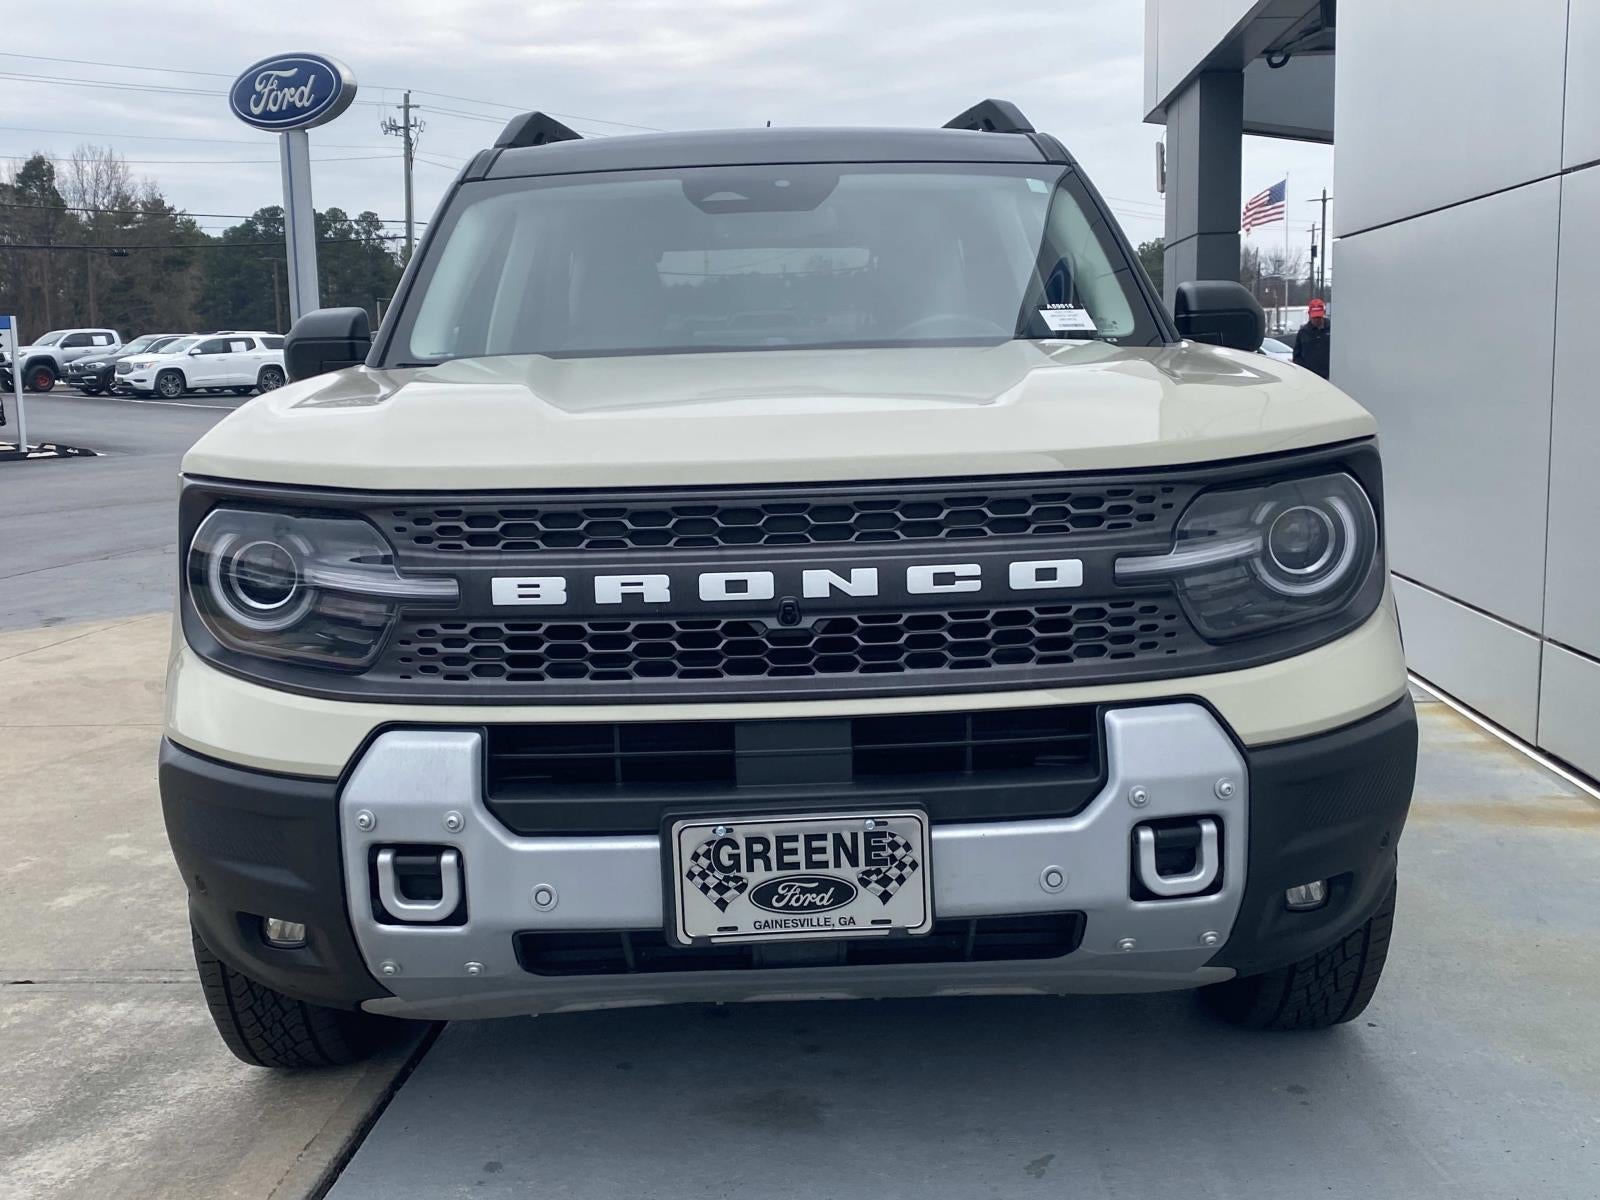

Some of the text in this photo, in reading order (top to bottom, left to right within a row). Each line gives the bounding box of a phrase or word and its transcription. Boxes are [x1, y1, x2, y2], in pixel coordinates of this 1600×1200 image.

[249, 67, 316, 115] Ford
[491, 558, 1083, 605] BRONCO
[711, 831, 890, 875] GREENE
[771, 881, 834, 908] Ford
[753, 916, 856, 930] GAINESVILLE, GA
